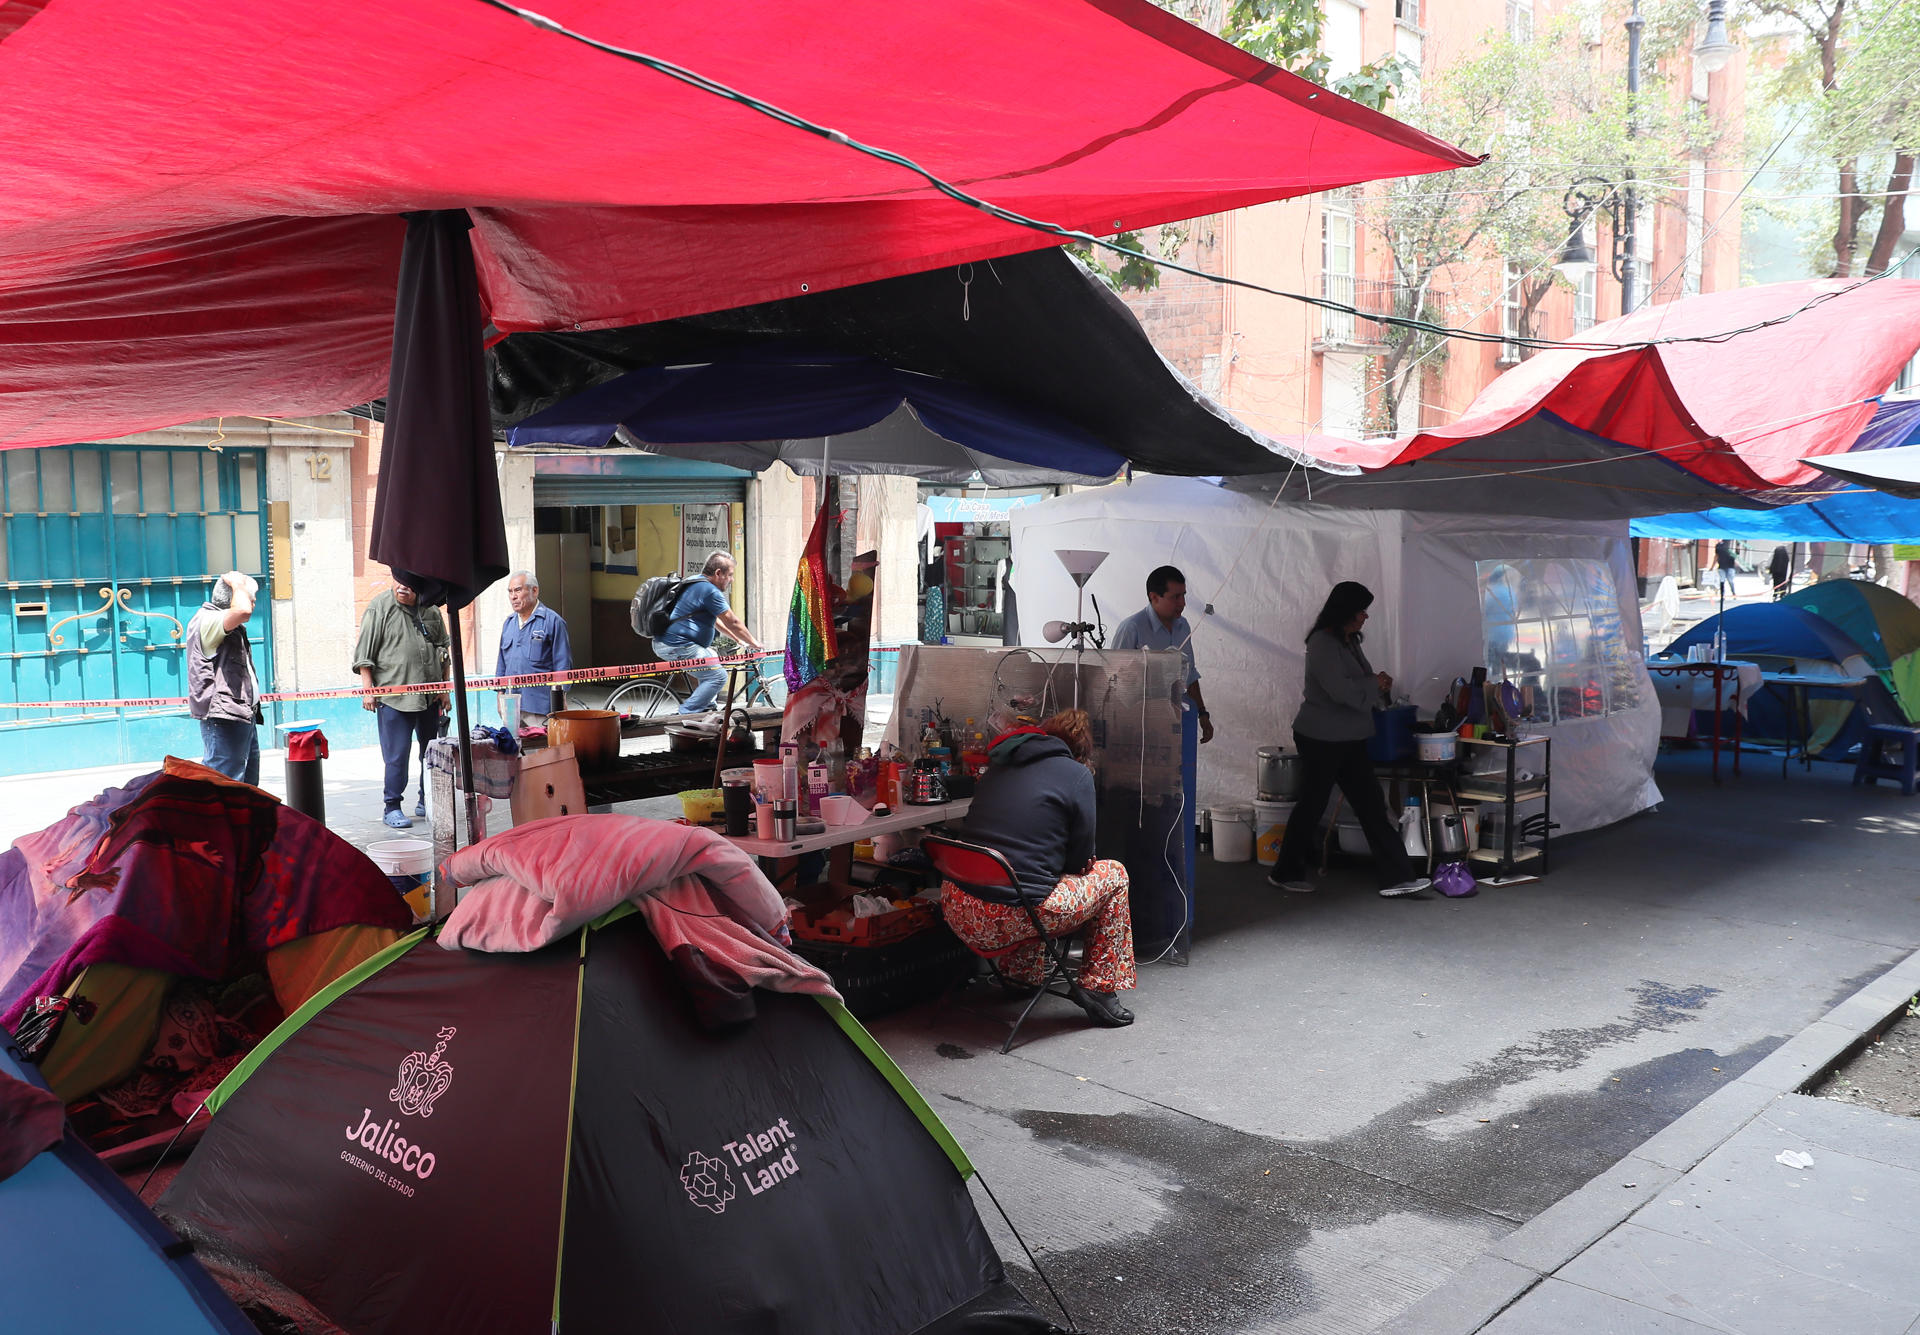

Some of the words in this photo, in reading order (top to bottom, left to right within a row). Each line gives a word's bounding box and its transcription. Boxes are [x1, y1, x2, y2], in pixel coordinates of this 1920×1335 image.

[305, 453, 331, 479] 12
[514, 673, 554, 685] PELIGRO
[567, 668, 606, 680] PELIGRO
[618, 662, 657, 674] PELIGRO
[346, 1107, 436, 1179] Jalisco
[722, 1117, 796, 1167] Talent
[340, 1150, 375, 1175] GOBIERNO
[375, 1168, 387, 1183] DEL
[387, 1176, 415, 1198] ESTADO
